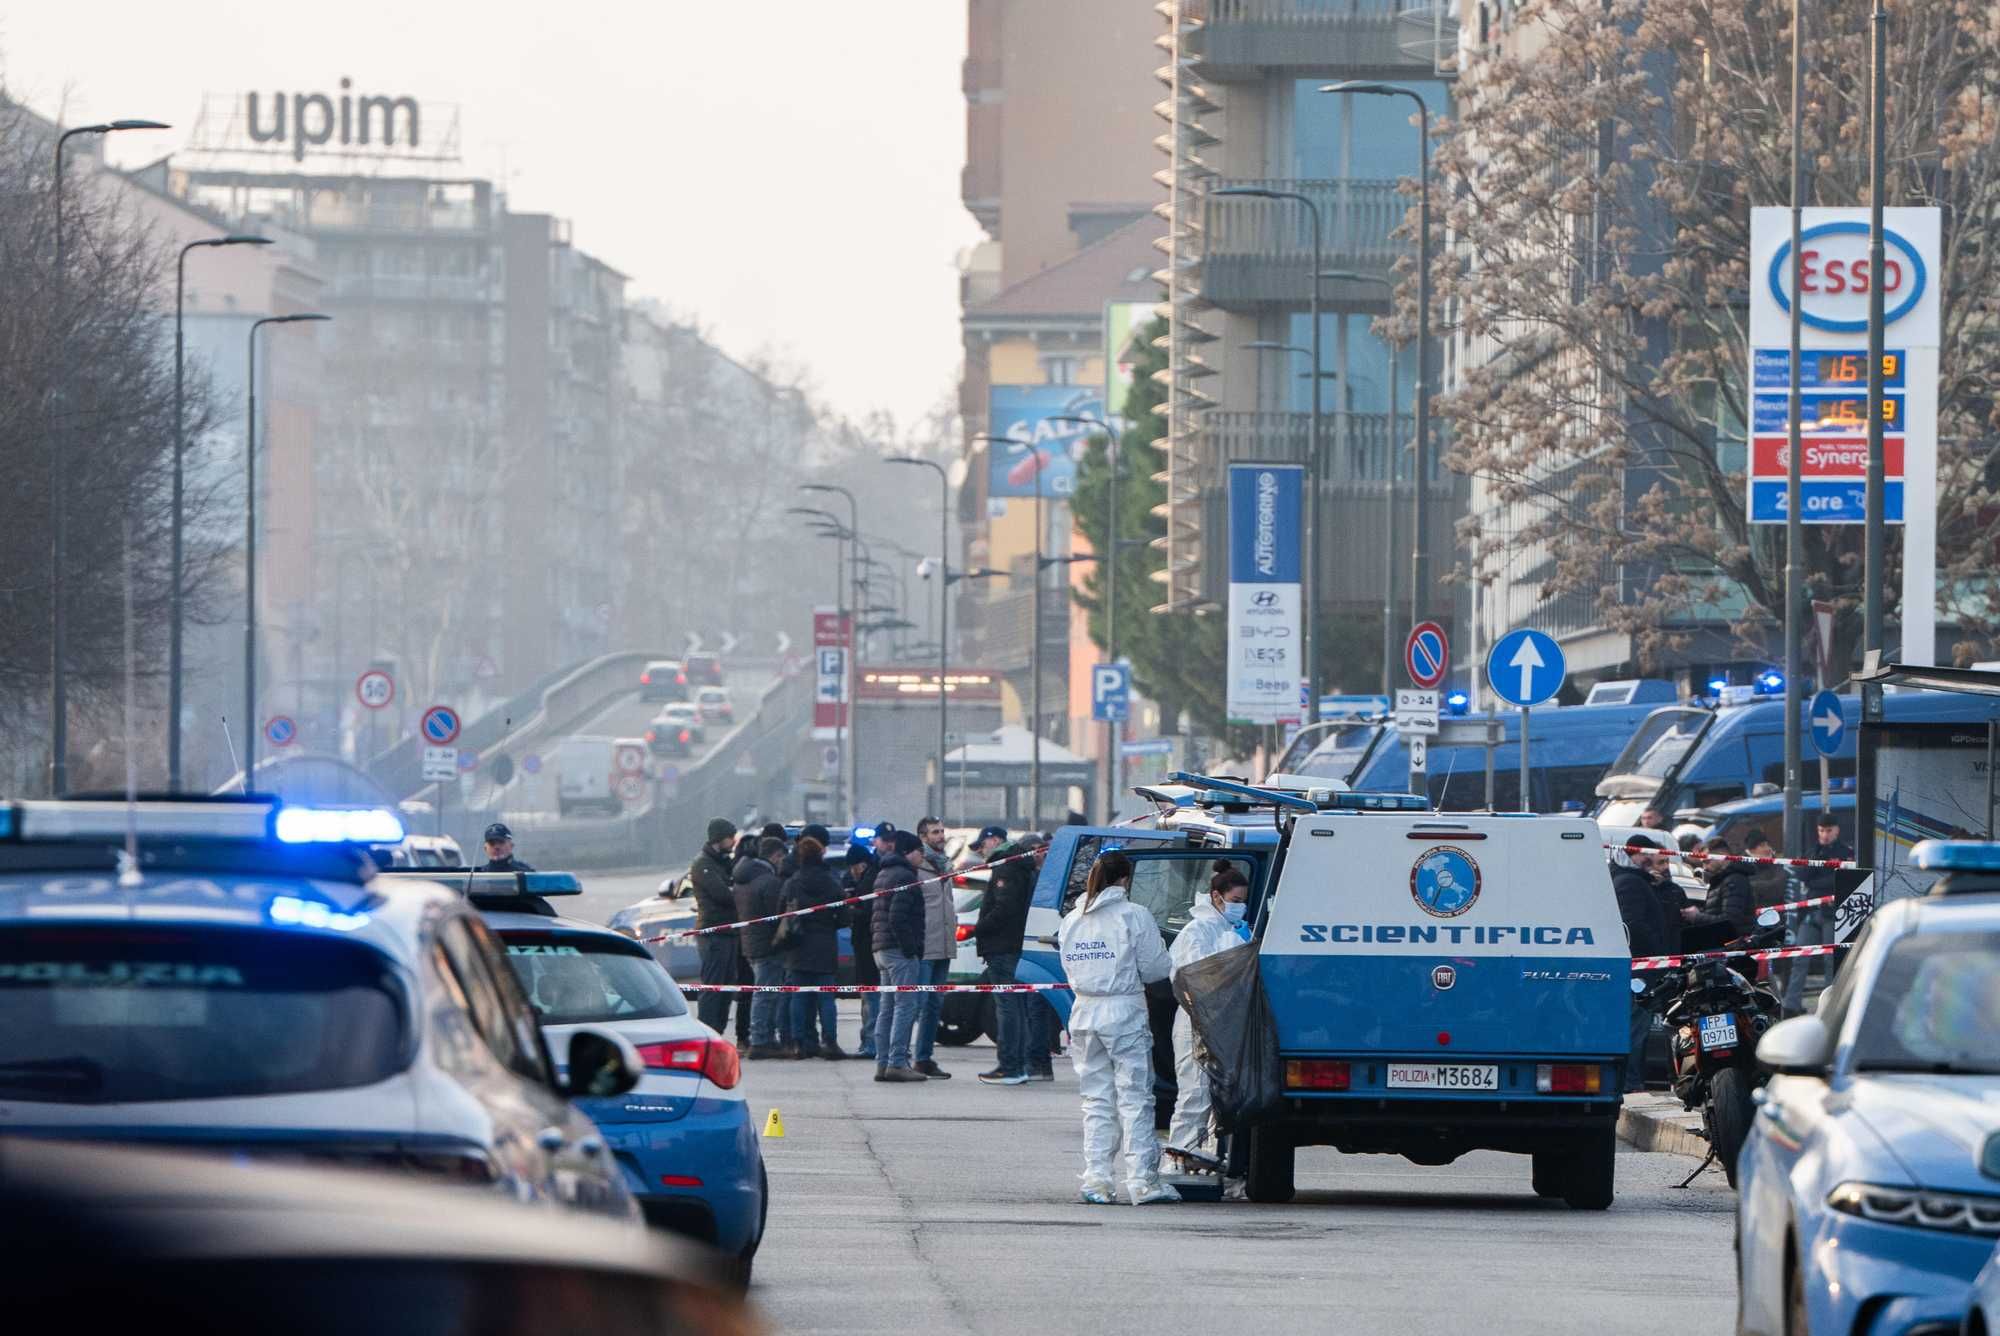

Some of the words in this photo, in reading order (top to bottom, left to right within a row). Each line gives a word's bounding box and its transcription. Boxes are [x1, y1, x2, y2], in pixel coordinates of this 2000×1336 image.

[248, 77, 418, 162] upim
[1806, 447, 1870, 470] Synerg
[1807, 496, 1843, 510] ore
[1258, 472, 1278, 576] AUTOTORINO
[1240, 626, 1290, 638] BYD
[1096, 669, 1122, 702] P
[1300, 925, 1595, 945] SCIENTIFICA
[1075, 941, 1106, 950] POLIZIA
[1066, 951, 1116, 961] SCIENTIFICA
[1437, 972, 1453, 984] FIAT
[1391, 1070, 1430, 1082] POLIZIA
[1437, 1067, 1493, 1087] M3684
[772, 1113, 778, 1125] 9
